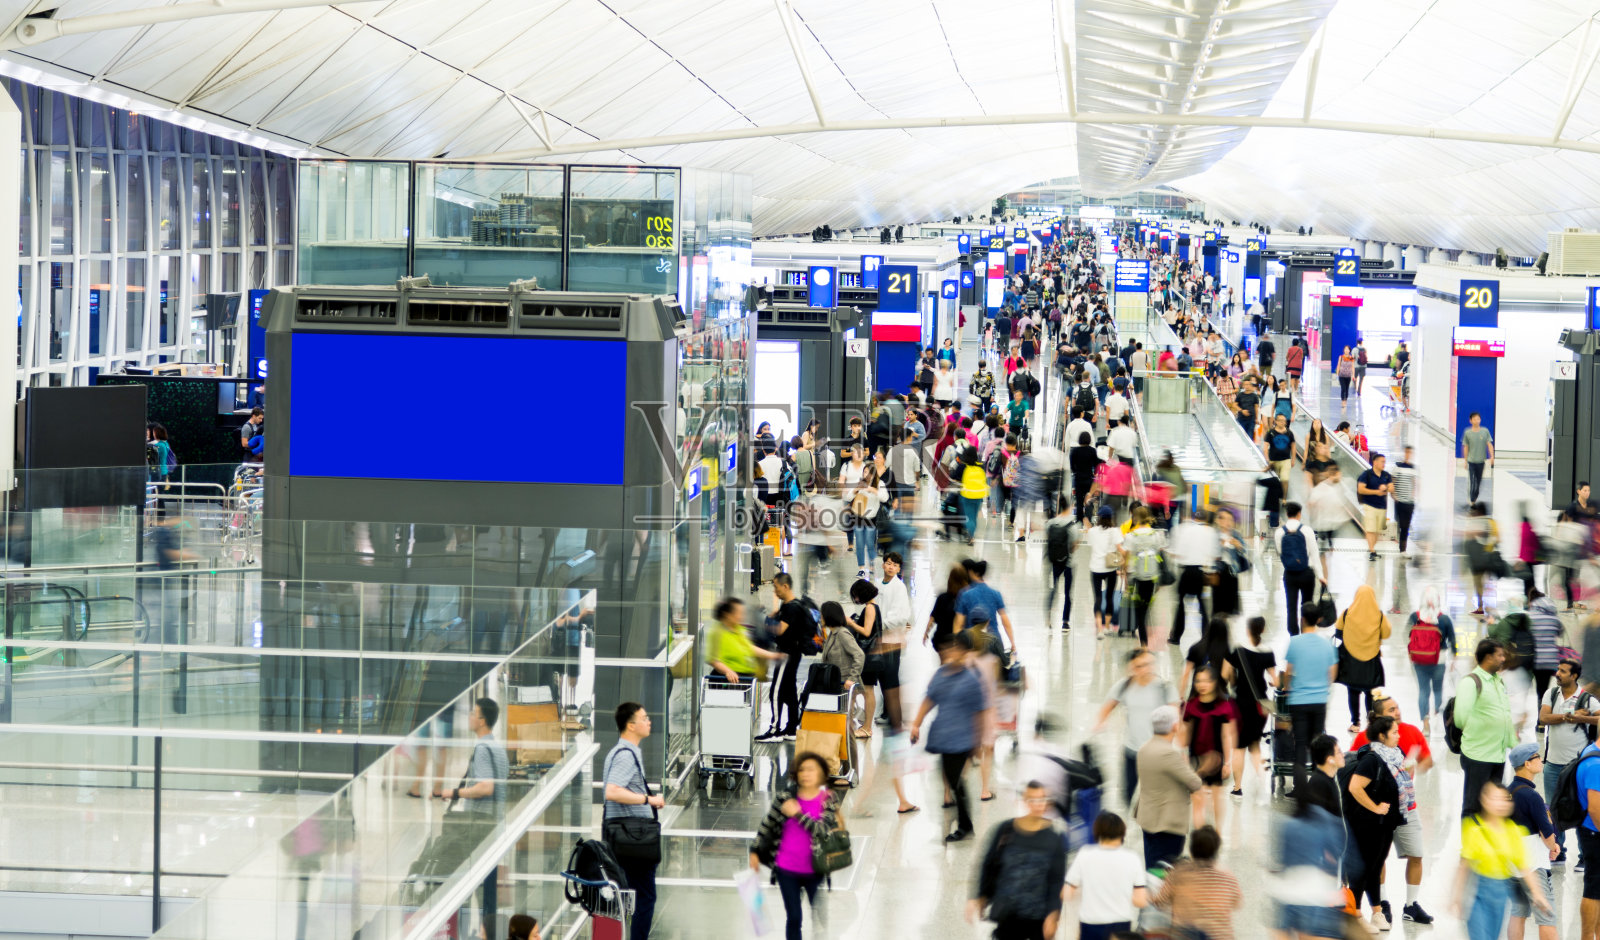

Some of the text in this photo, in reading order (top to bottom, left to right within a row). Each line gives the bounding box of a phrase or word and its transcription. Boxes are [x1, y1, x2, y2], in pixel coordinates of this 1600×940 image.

[1015, 230, 1026, 238] 25
[990, 238, 1003, 249] 23
[1247, 242, 1259, 251] 24
[1337, 259, 1356, 275] 22
[887, 272, 911, 294] 21
[1464, 287, 1493, 309] 20
